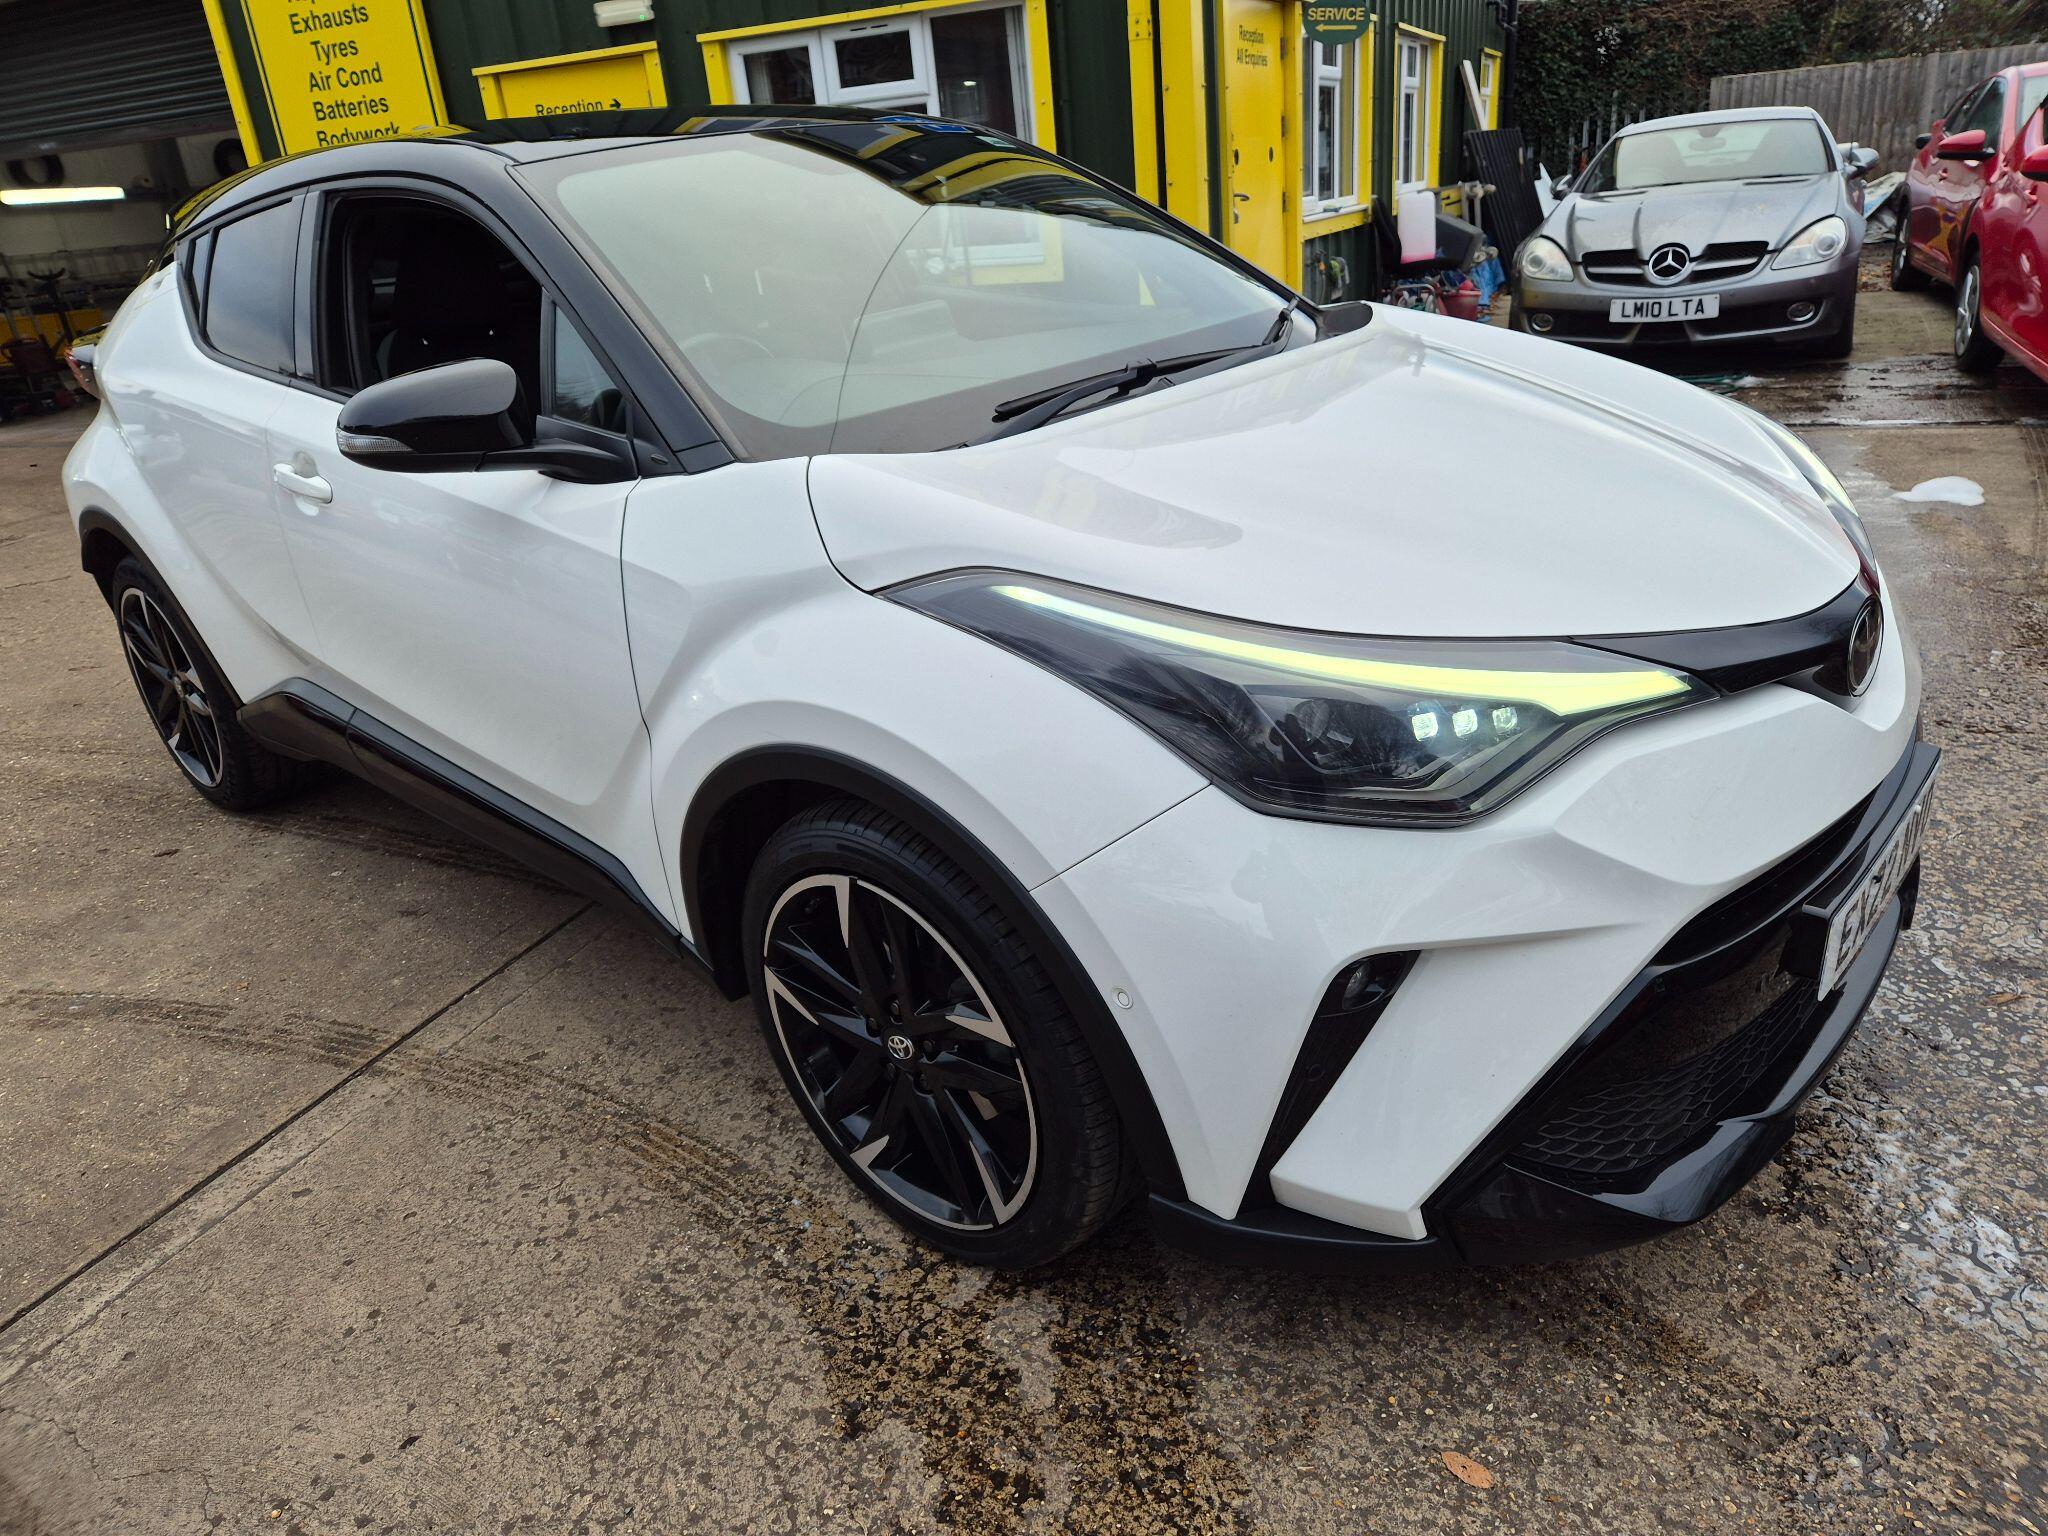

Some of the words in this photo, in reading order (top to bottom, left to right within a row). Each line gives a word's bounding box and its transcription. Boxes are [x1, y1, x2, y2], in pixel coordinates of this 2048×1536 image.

[289, 4, 369, 34] Exhausts
[1308, 7, 1365, 21] SERVICE
[1239, 24, 1264, 46] Reception
[310, 40, 358, 66] Tyres
[1245, 49, 1268, 69] Enquiries
[309, 71, 331, 92] Air
[336, 62, 383, 88] Cond
[312, 95, 389, 121] Batteries
[535, 99, 603, 116] Reception
[1668, 298, 1704, 317] LTA
